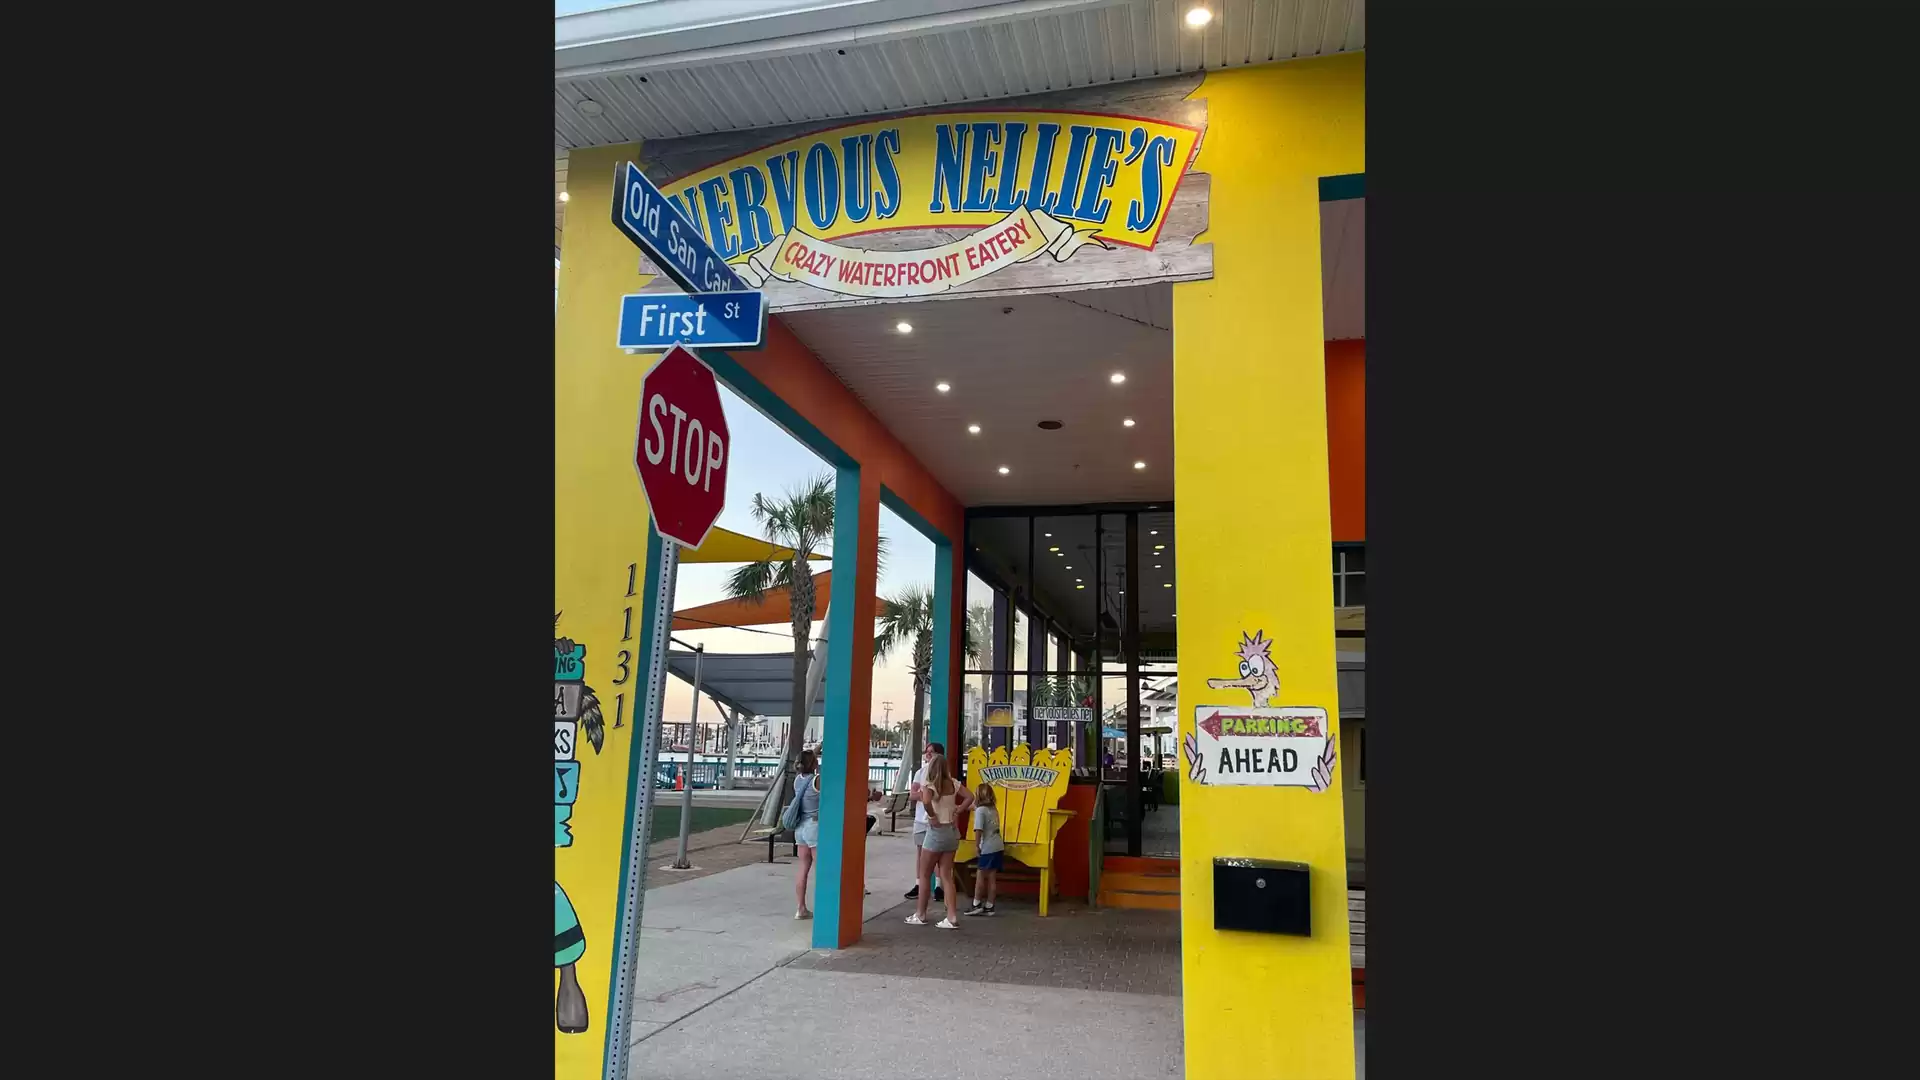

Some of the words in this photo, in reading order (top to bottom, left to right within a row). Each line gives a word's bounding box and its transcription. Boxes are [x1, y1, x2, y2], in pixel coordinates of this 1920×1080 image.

[665, 128, 901, 260] NERVOUS
[929, 122, 1177, 232] NELLIE'S
[629, 181, 661, 239] Old
[667, 220, 697, 274] San
[784, 241, 836, 279] CRAZY
[837, 252, 961, 287] WATERFRONT
[967, 217, 1033, 271] EATERY
[639, 303, 707, 338] First
[724, 301, 741, 319] St
[644, 393, 724, 493] STOP
[1218, 746, 1299, 774] AHEAD
[1220, 717, 1306, 735] PARKING
